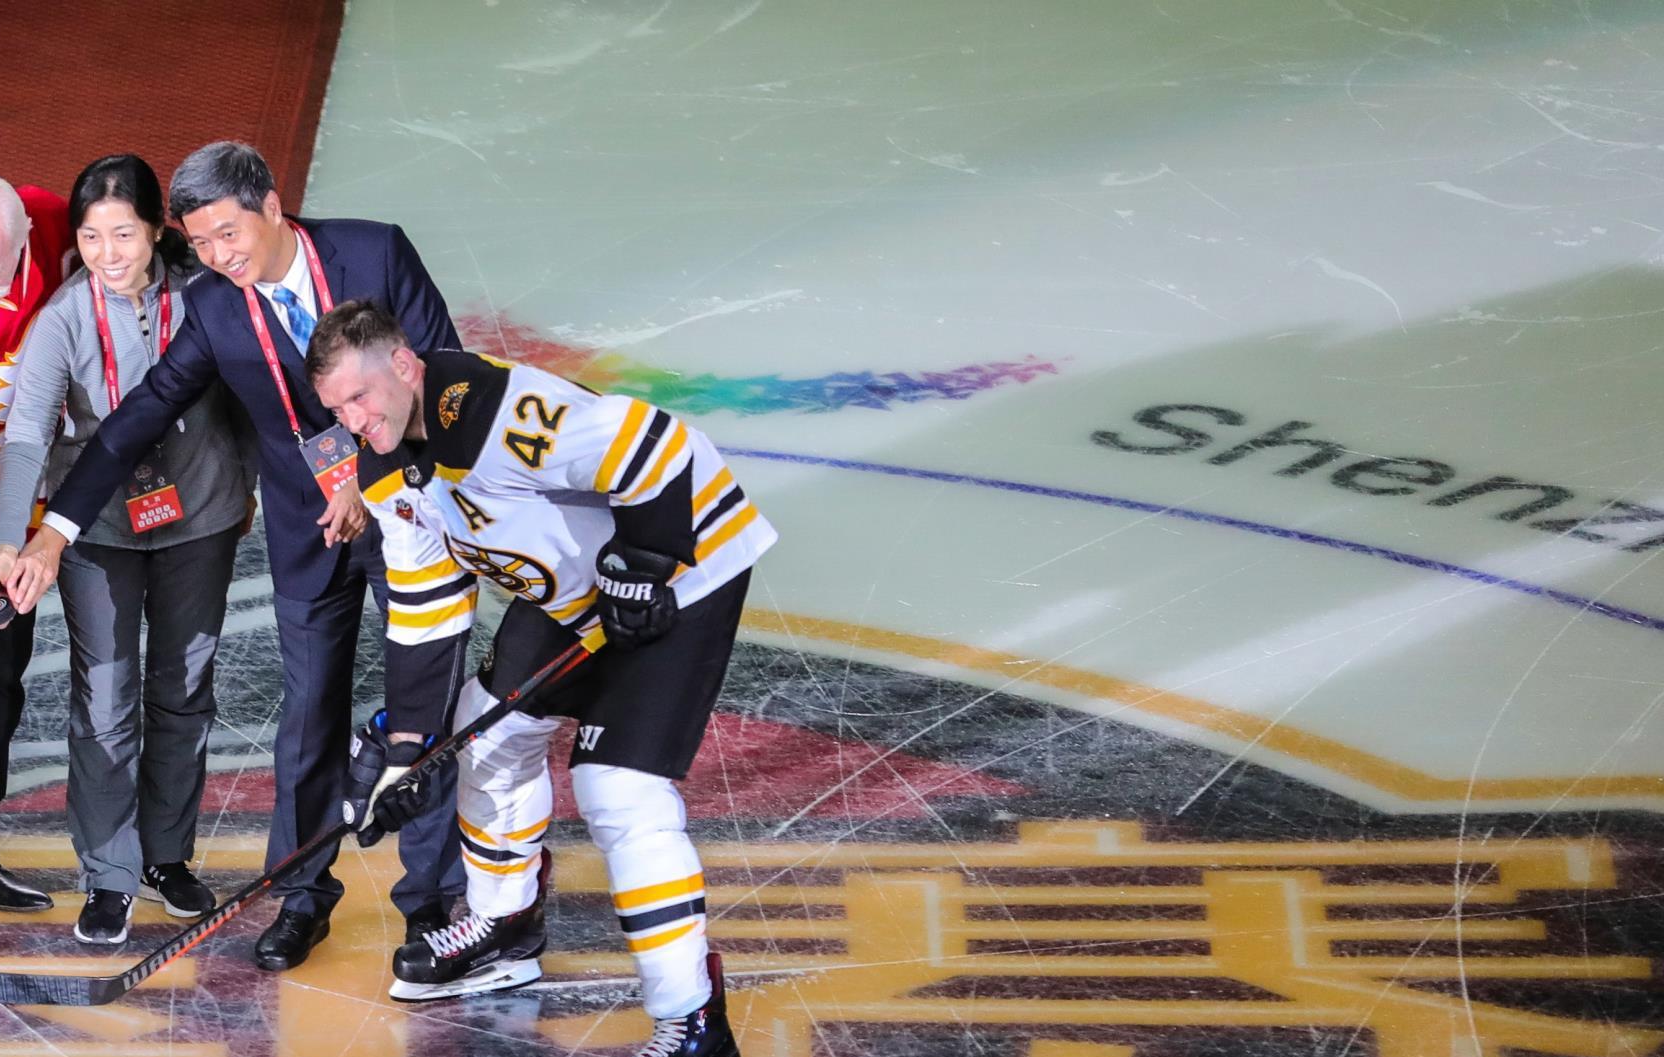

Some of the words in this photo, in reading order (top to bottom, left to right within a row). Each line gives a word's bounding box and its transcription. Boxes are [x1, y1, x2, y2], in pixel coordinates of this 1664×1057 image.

[502, 391, 571, 471] 42
[447, 487, 497, 536] A
[1089, 401, 1664, 556] Shenz
